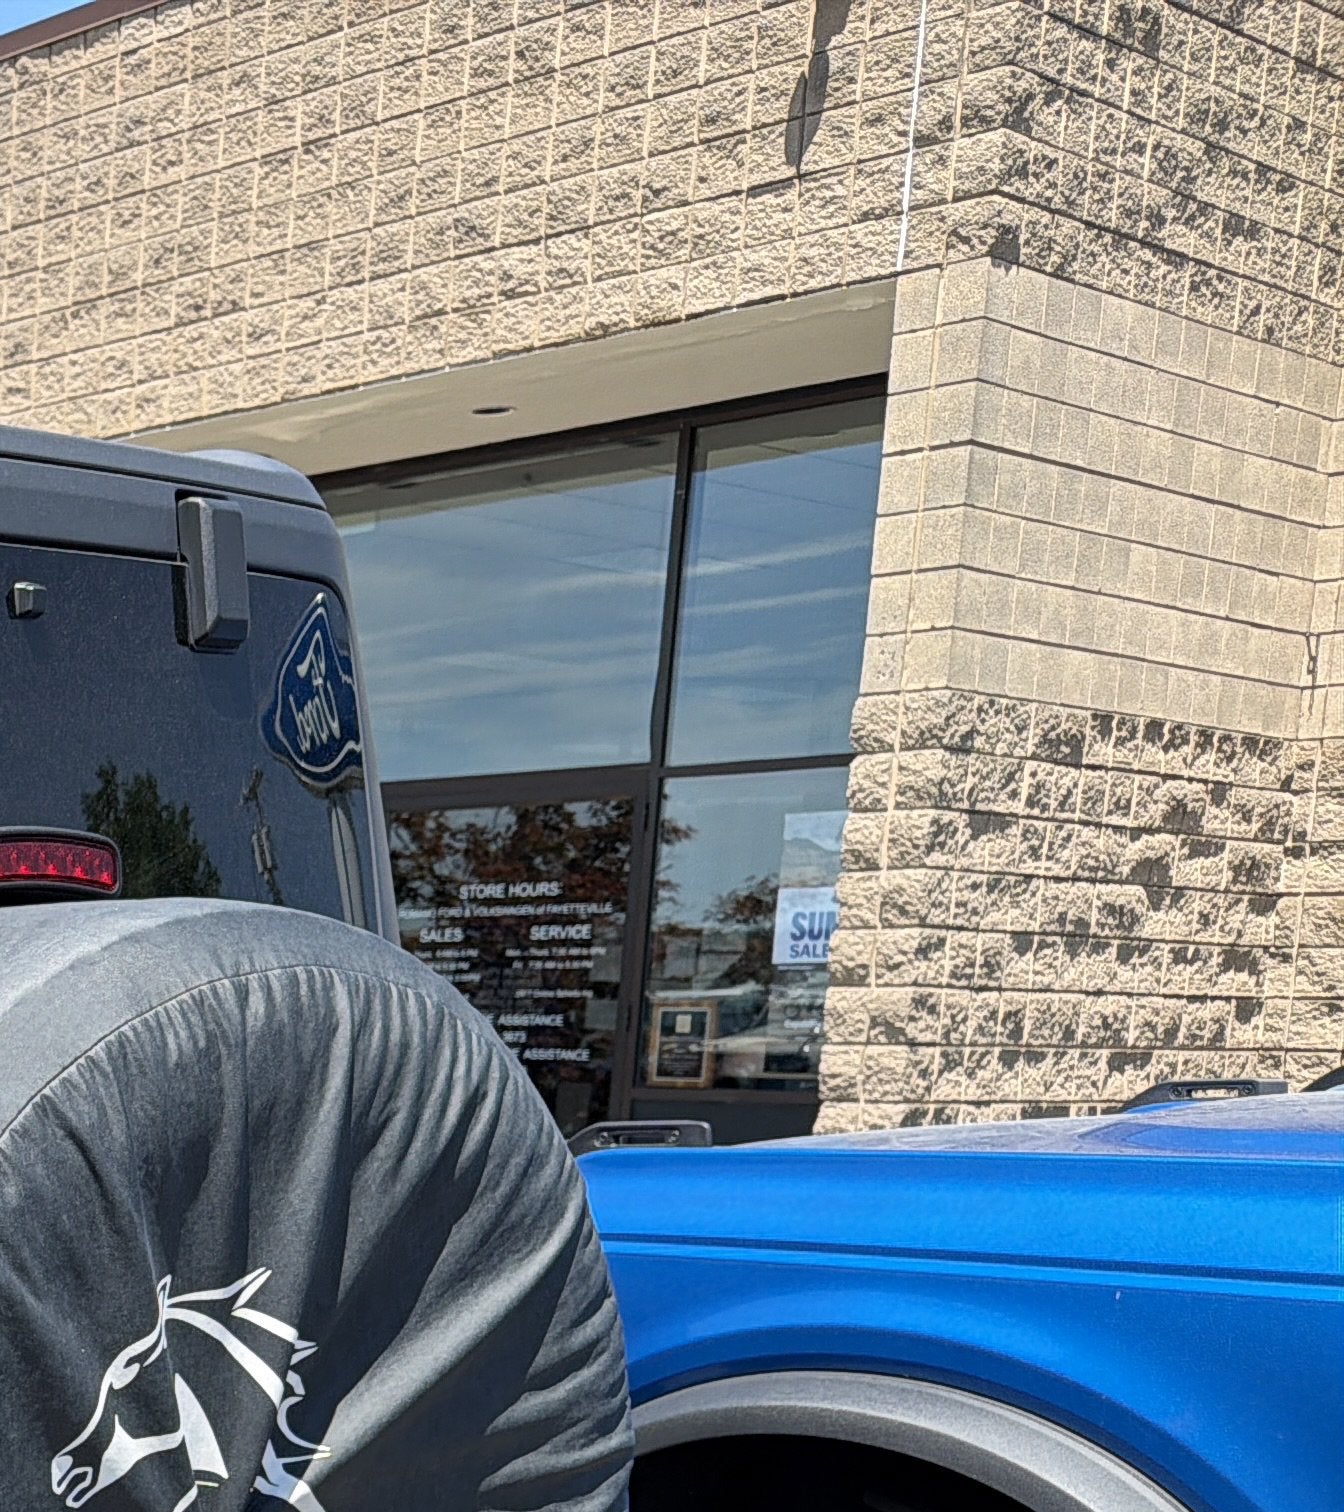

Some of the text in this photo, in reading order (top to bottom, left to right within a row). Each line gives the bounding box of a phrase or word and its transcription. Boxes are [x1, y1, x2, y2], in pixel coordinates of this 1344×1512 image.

[459, 884, 505, 899] STORE
[419, 927, 463, 943] SALES
[529, 924, 592, 940] SERVICE
[497, 1014, 564, 1027] ASSISTANCE
[523, 1047, 590, 1061] ASSISTANCE
